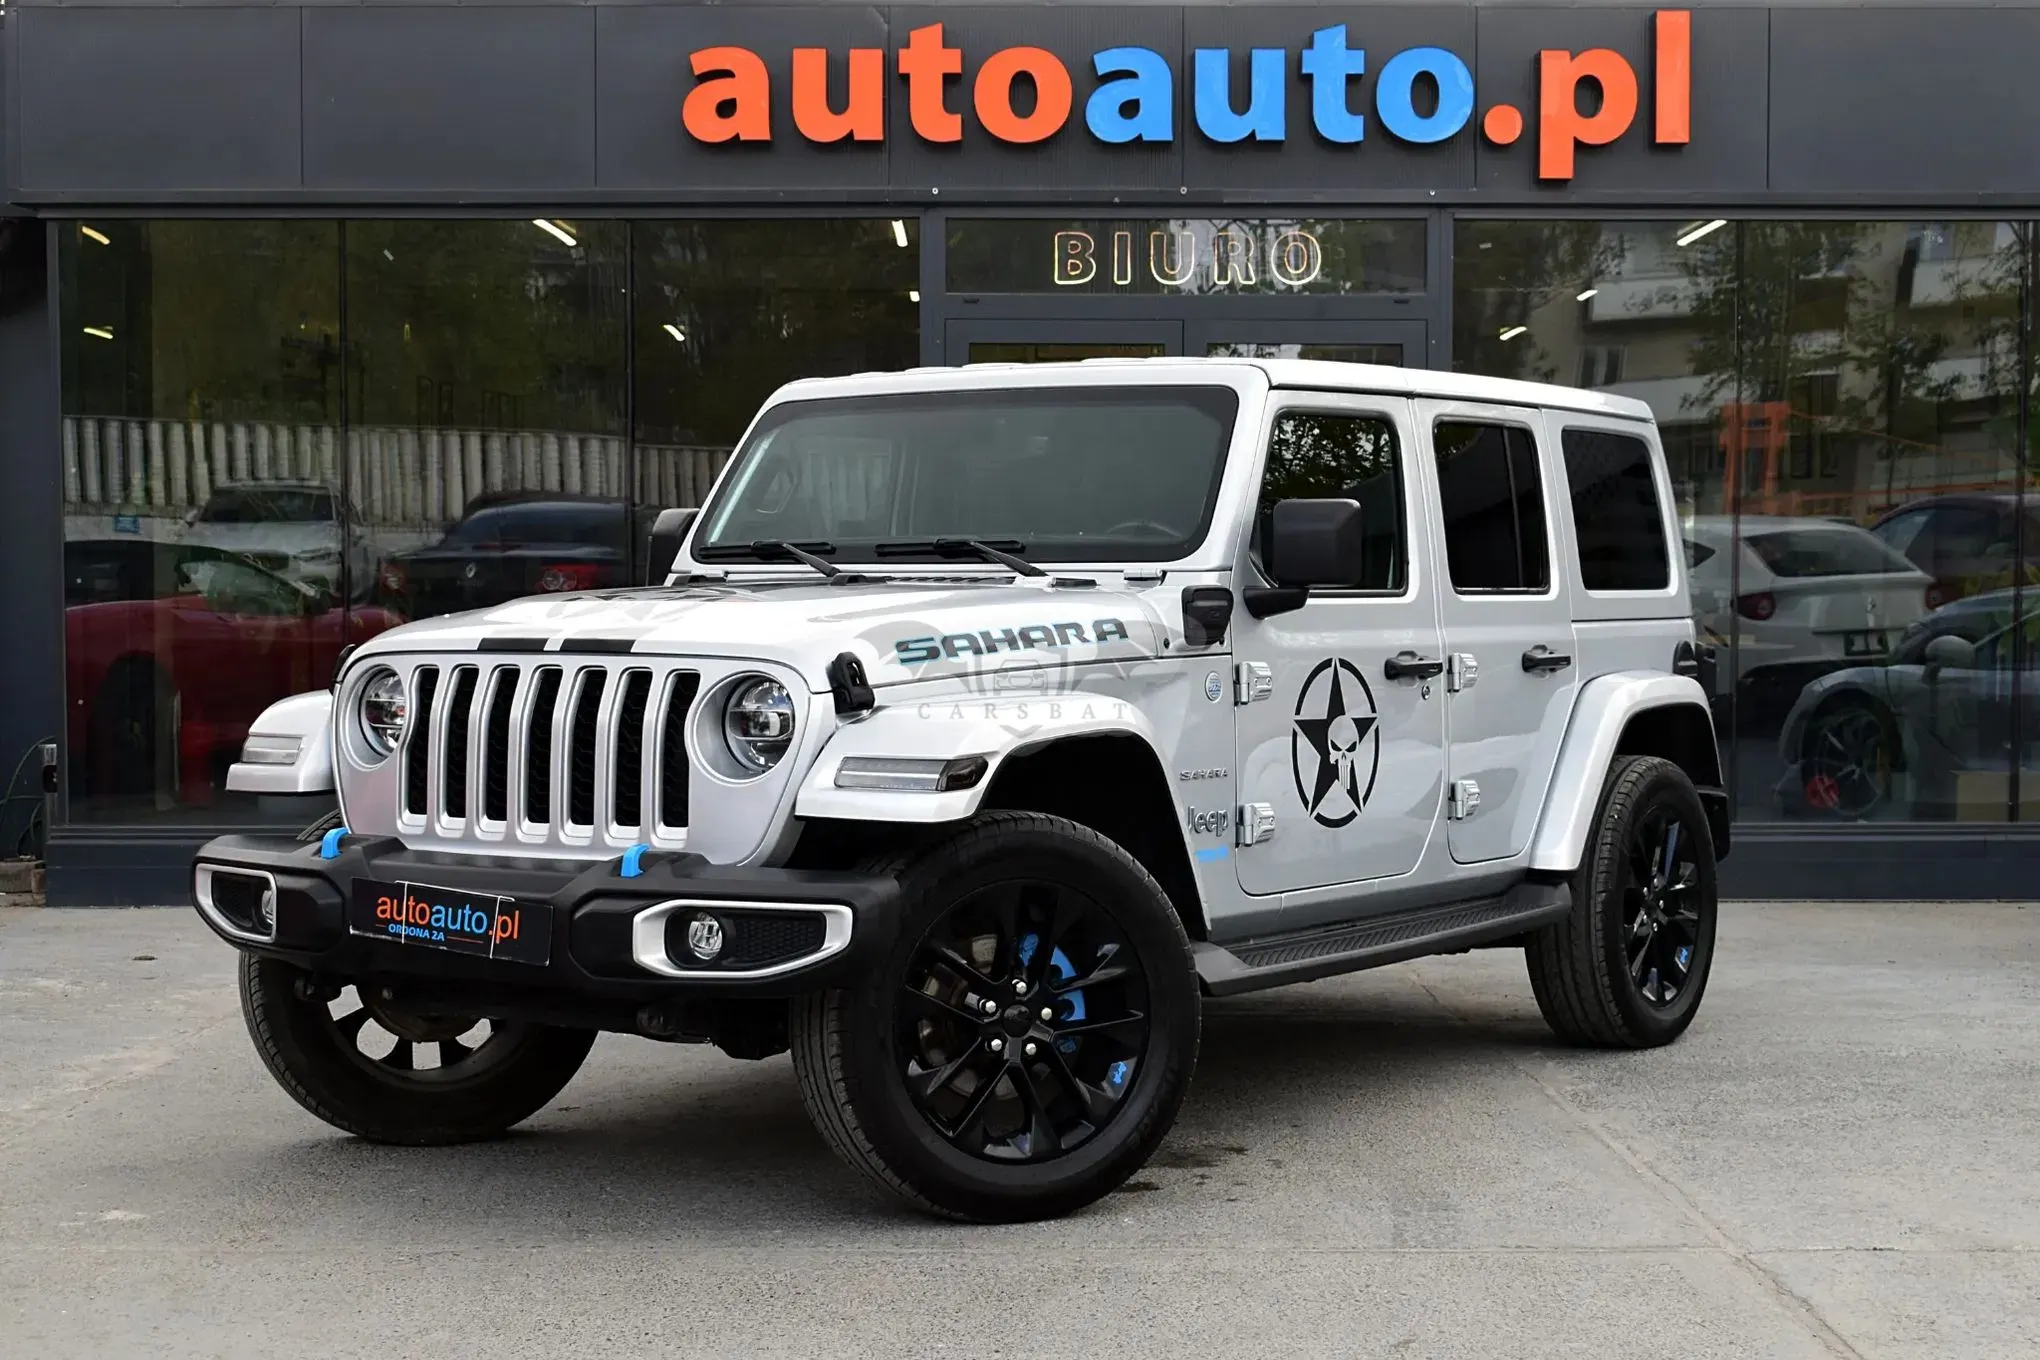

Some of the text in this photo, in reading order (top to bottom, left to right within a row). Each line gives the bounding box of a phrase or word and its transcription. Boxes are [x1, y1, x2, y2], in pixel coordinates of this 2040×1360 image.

[682, 10, 1690, 180] autoauto.pl
[1054, 231, 1321, 285] BIURO
[895, 617, 1129, 665] SAHARA
[1180, 767, 1229, 781] SAHARA
[1187, 805, 1229, 837] Jeep
[376, 896, 520, 944] autoauto.pl
[431, 930, 445, 942] 2A
